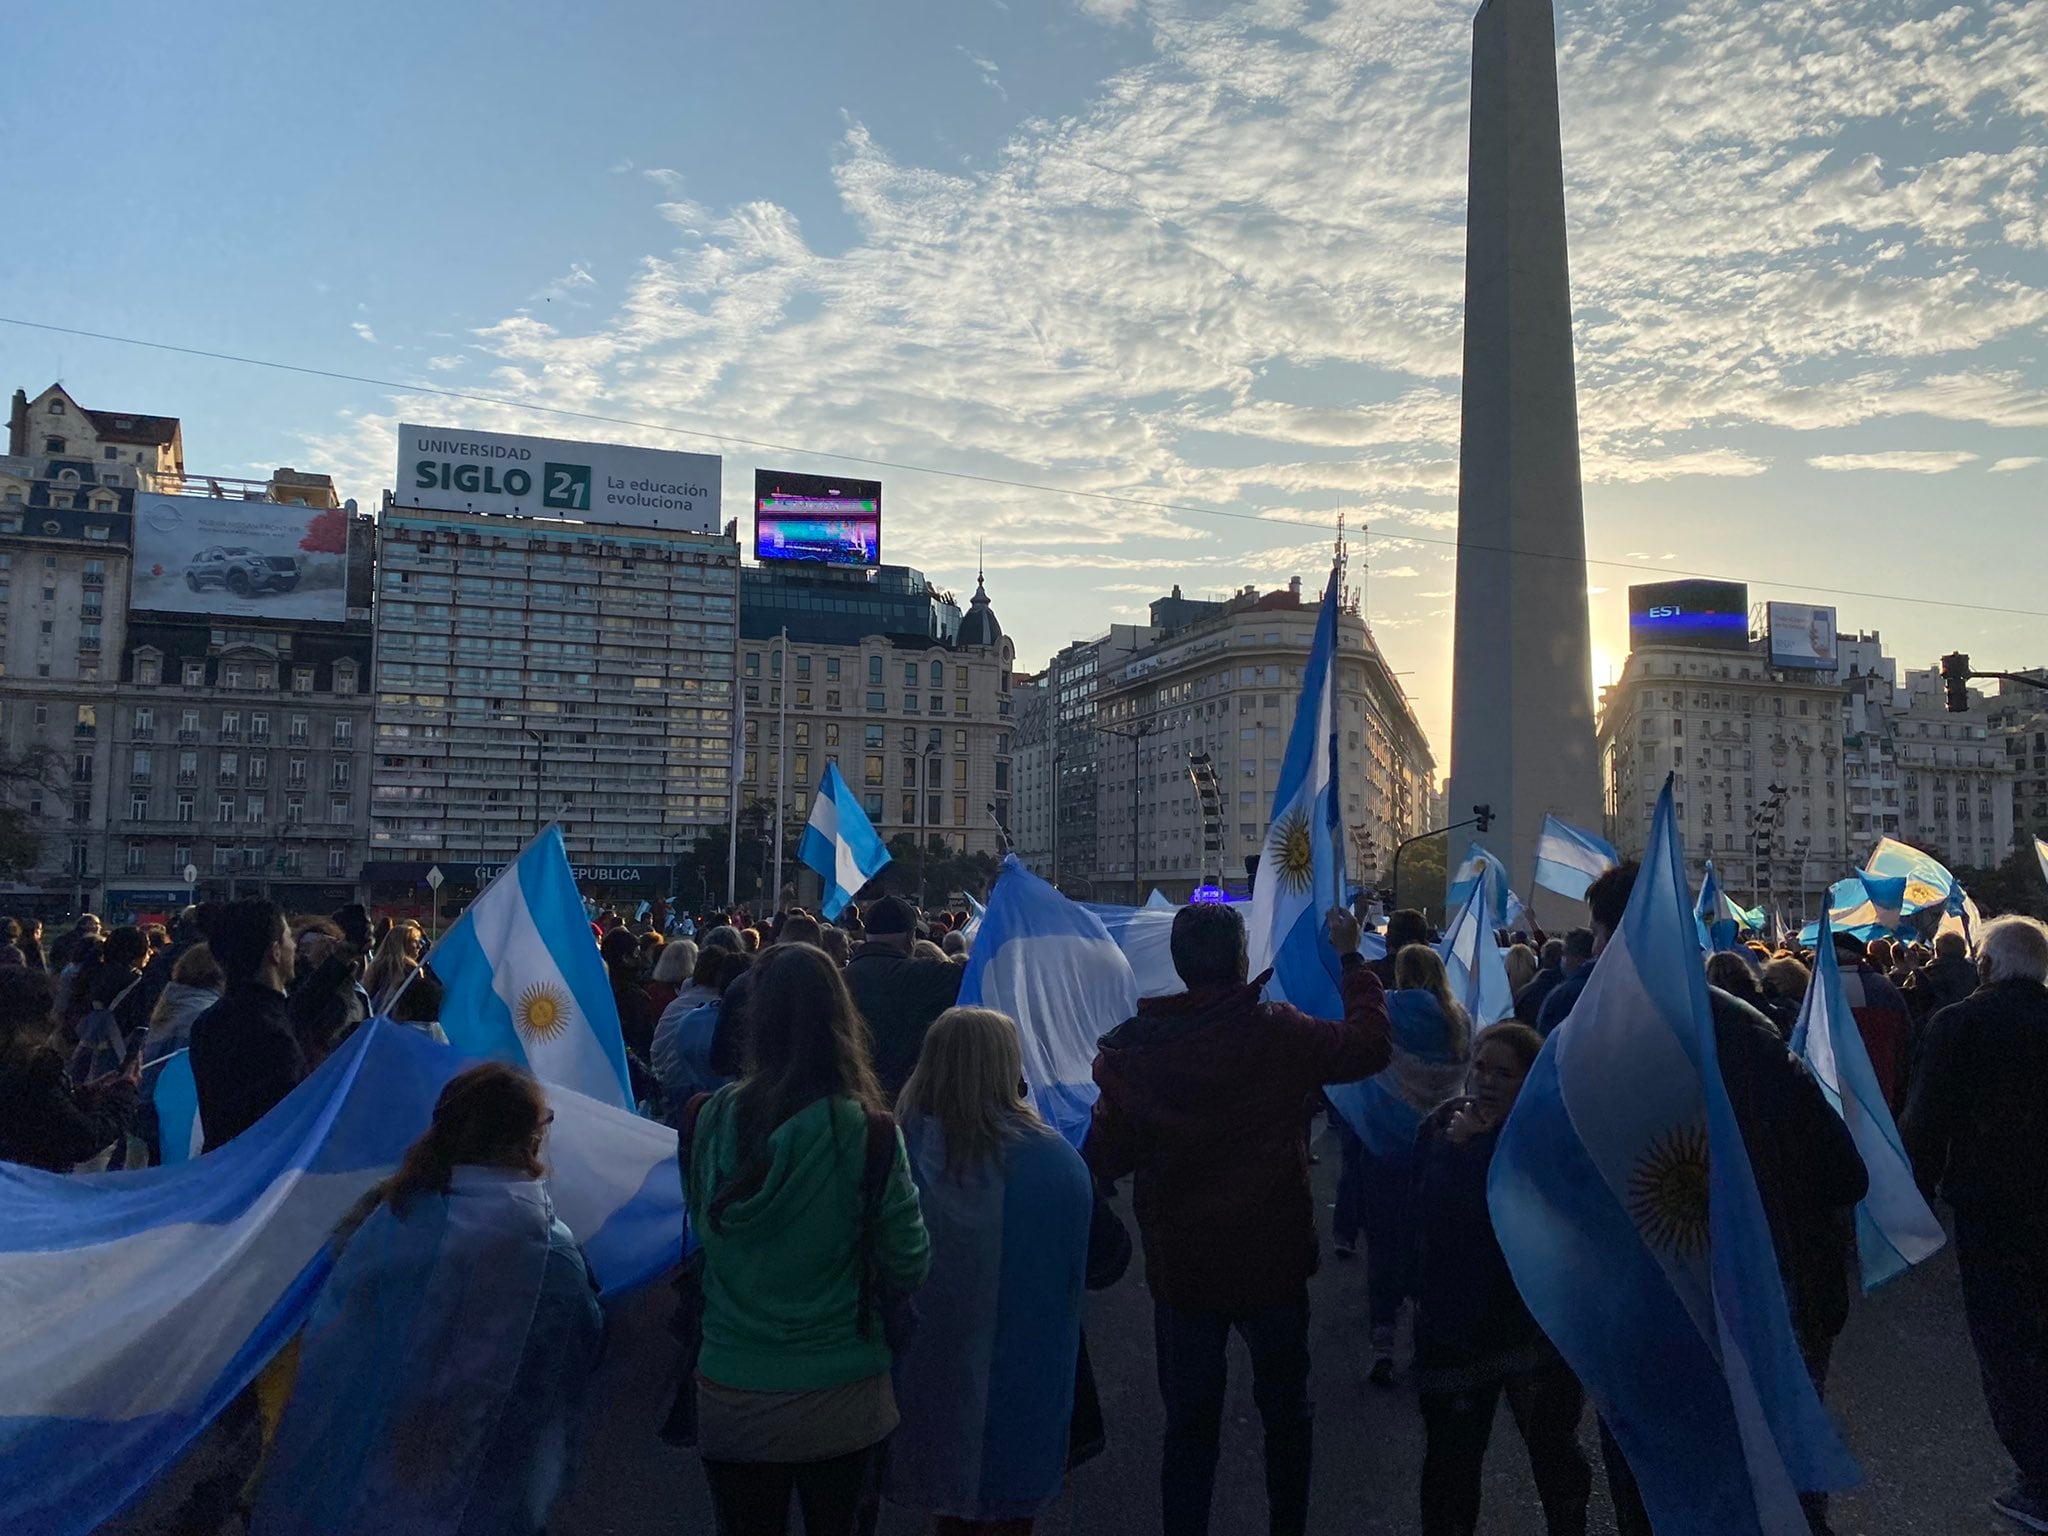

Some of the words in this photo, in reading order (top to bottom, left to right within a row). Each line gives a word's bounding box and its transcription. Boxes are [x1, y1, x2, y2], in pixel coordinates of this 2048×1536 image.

[417, 438, 532, 461] UNIVERSIDAD
[415, 460, 532, 497] SIGLO
[549, 471, 584, 508] 21
[607, 476, 625, 490] La
[629, 478, 709, 498] educación
[606, 493, 694, 511] evoluciona
[394, 527, 508, 550] HOTEL
[570, 866, 641, 881] EPÚBLICA
